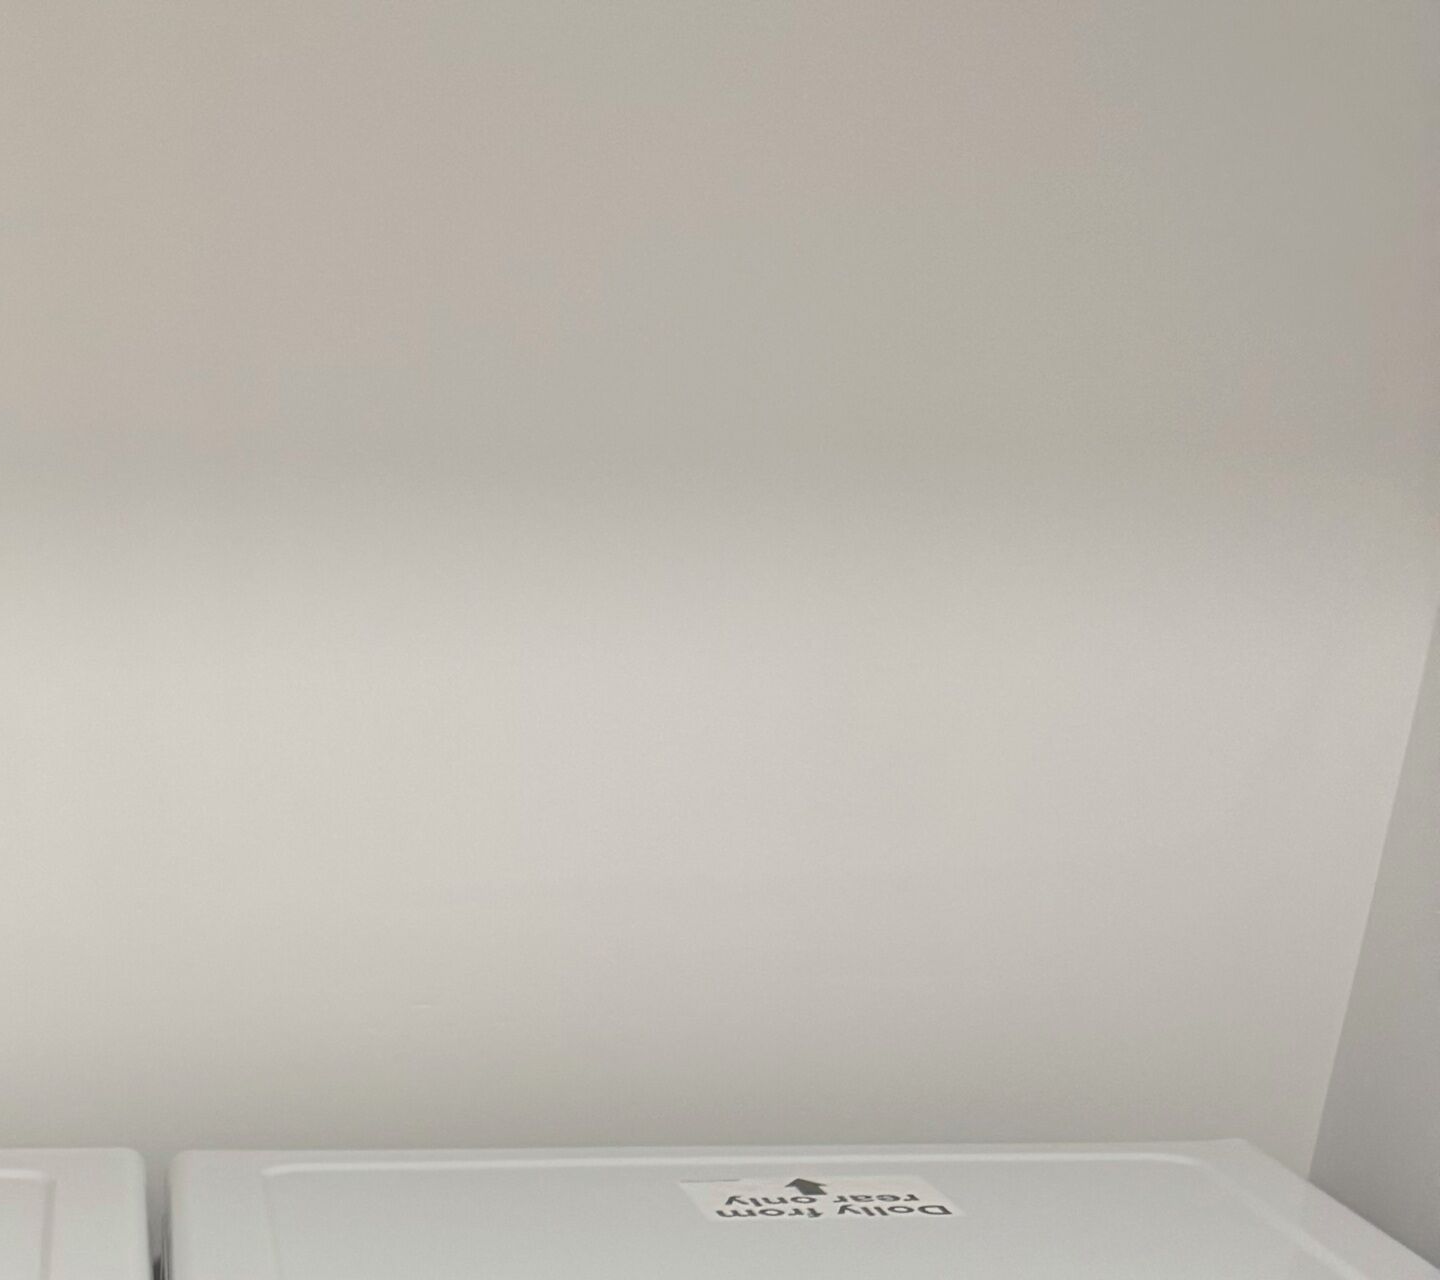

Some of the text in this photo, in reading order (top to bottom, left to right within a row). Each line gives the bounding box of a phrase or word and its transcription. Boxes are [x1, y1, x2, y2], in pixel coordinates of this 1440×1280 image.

[724, 1194, 920, 1207] rear only
[716, 1204, 952, 1219] Dolly from
